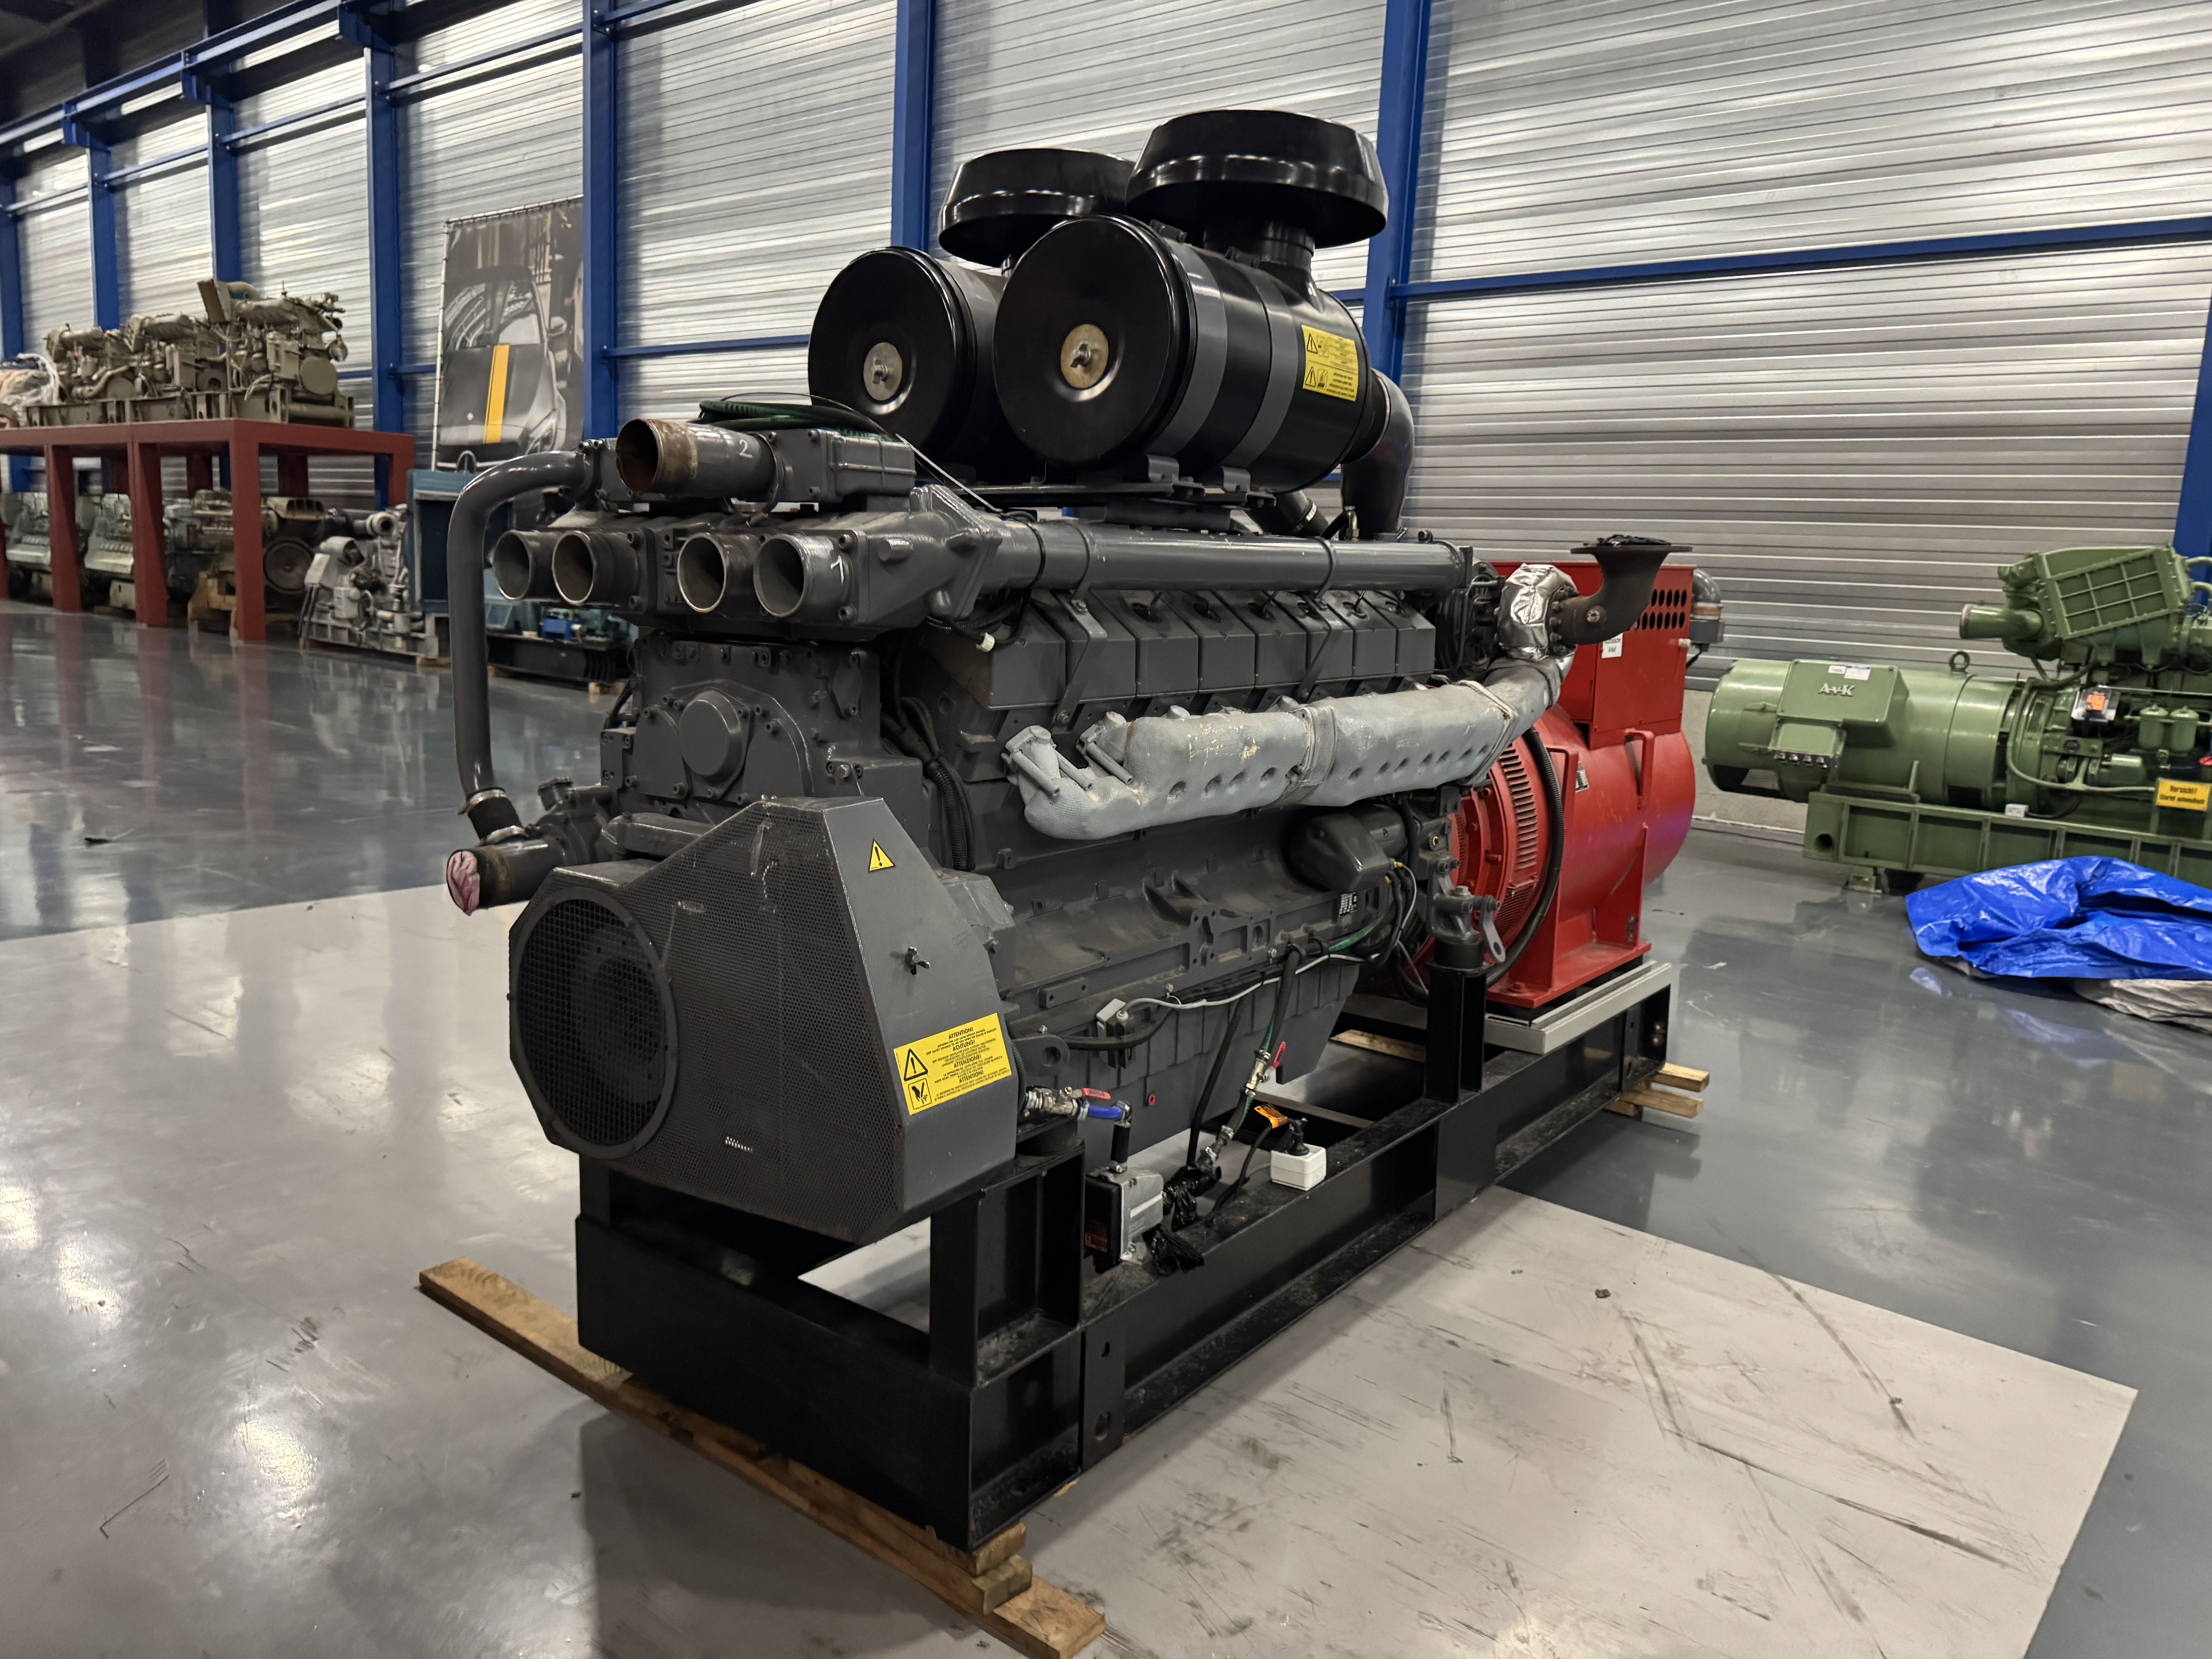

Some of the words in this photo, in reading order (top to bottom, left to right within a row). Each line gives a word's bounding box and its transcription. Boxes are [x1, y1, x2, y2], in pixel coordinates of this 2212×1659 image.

[739, 440, 753, 458] 2
[831, 555, 844, 585] 1
[949, 1027, 974, 1039] ATTENTION!
[953, 1039, 975, 1051] ACHTUNG!
[954, 1054, 981, 1068] ATTENZIONE!
[959, 1070, 984, 1084] ATTENTION!
